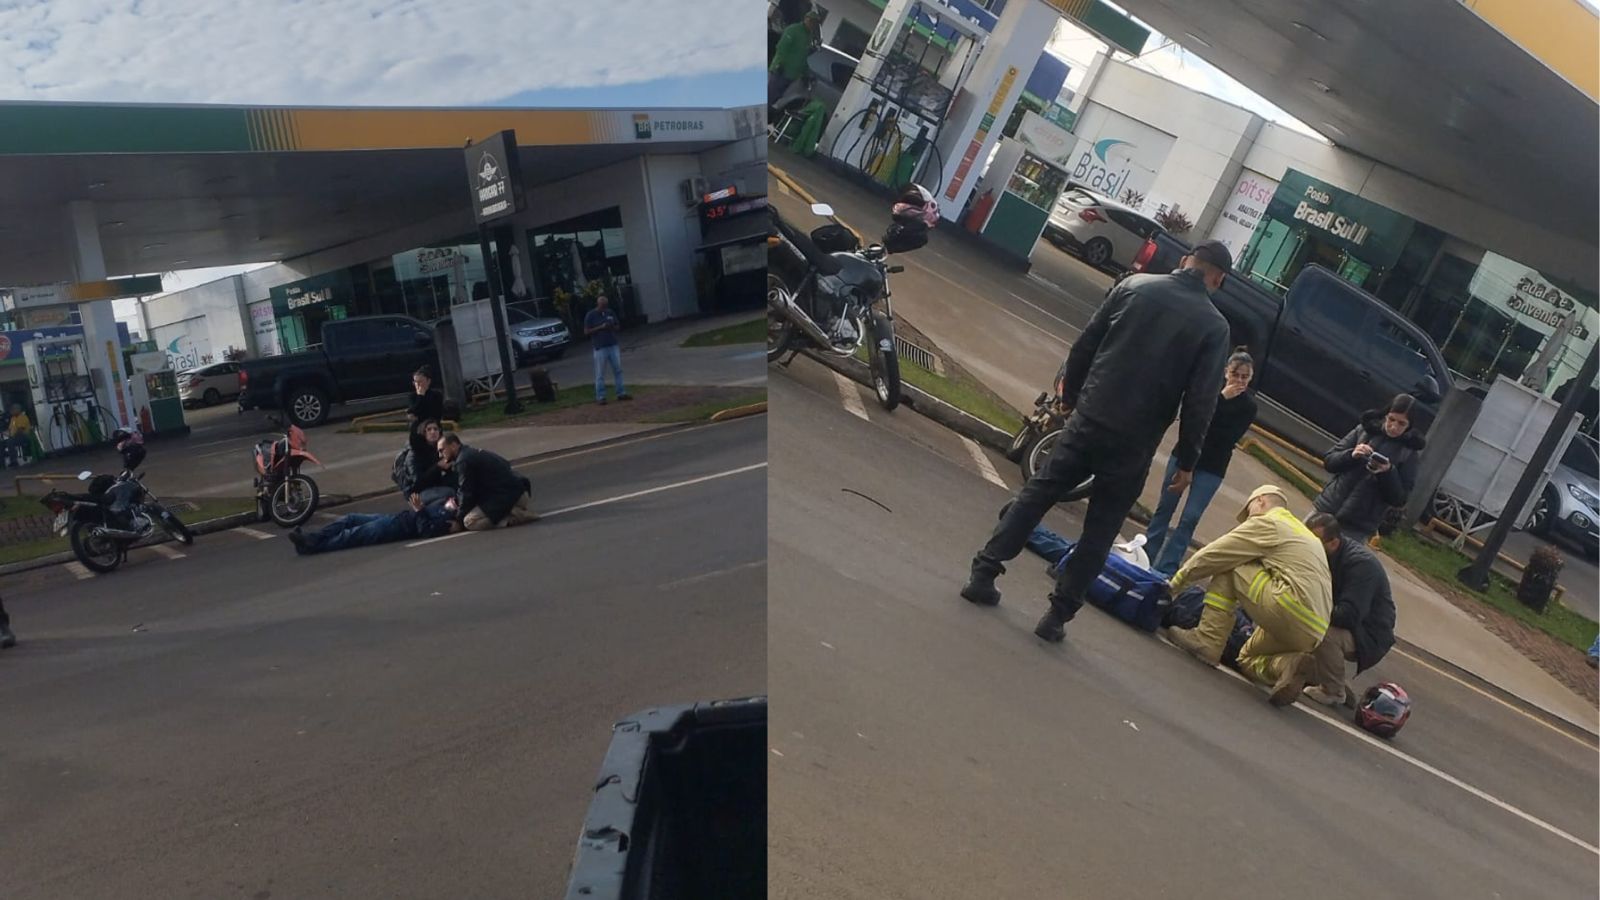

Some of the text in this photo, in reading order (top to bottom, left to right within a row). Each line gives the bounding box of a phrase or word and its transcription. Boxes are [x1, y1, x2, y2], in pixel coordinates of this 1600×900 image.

[654, 120, 704, 131] PETROBRAS
[1073, 152, 1131, 200] Brasil
[1236, 179, 1257, 198] pit
[1304, 185, 1330, 204] Posto
[1293, 201, 1334, 230] Brasil
[1331, 216, 1357, 239] Sul
[287, 293, 311, 310] Brasil
[167, 347, 199, 369] Brasil
